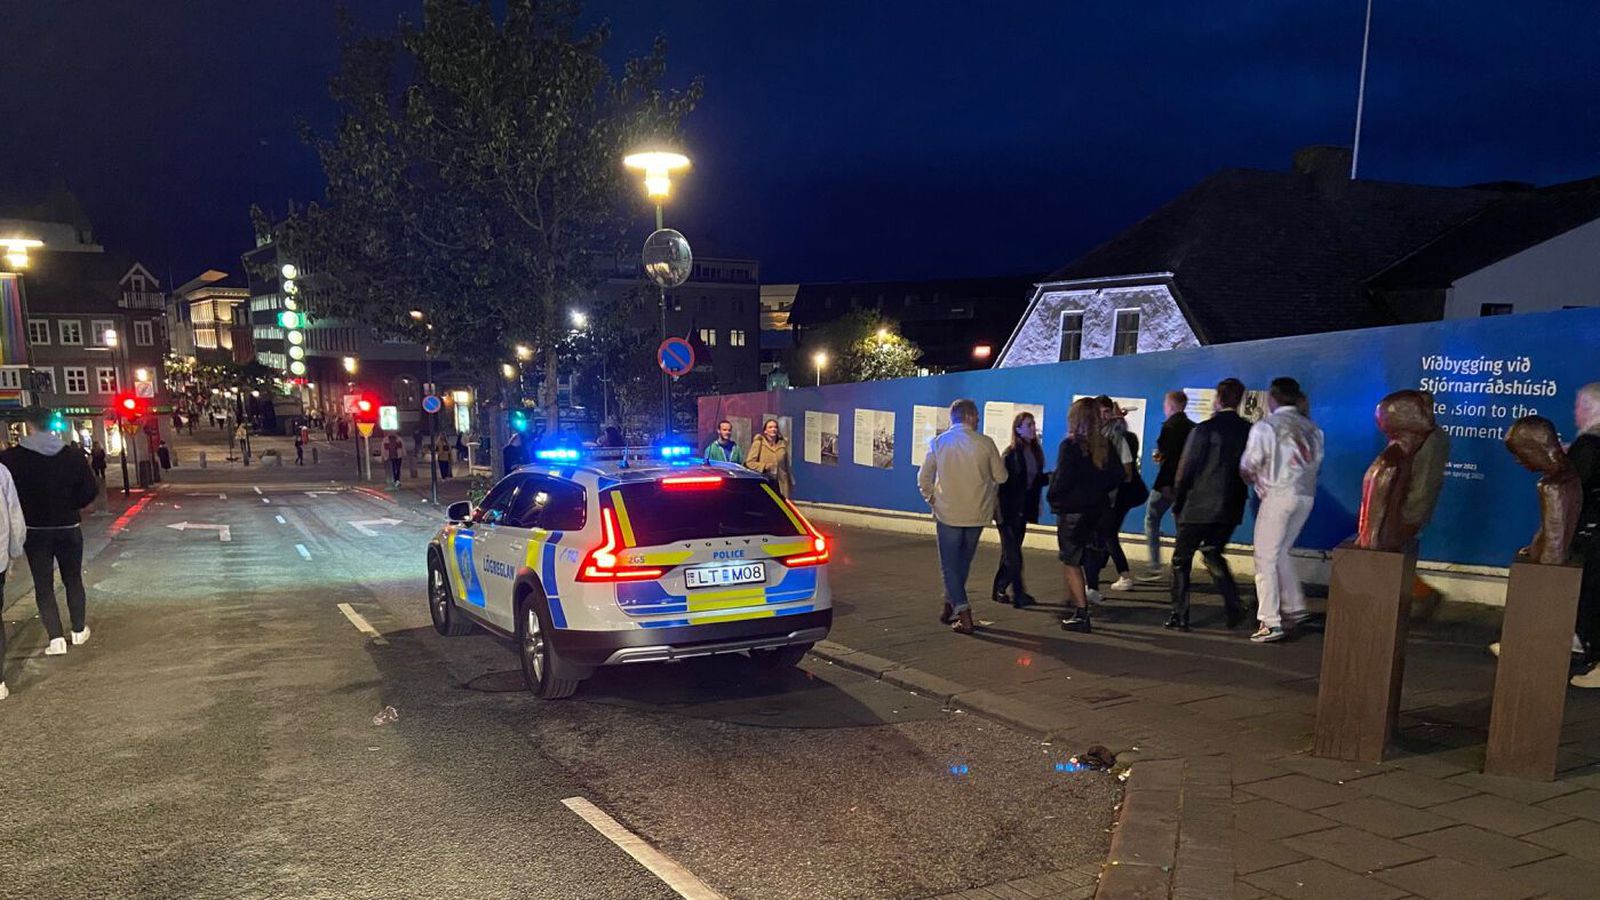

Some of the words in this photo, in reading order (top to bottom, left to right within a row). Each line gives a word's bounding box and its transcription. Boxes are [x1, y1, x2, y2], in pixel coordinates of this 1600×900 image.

[1422, 355, 1503, 375] Viðbygging
[1507, 356, 1531, 373] við
[1420, 376, 1557, 397] Stjórnarráðshúsið
[1491, 404, 1507, 418] to
[1511, 403, 1538, 419] the
[1441, 424, 1503, 440] ernment
[684, 537, 768, 549] VOLVO
[713, 549, 745, 560] POLICE
[698, 570, 719, 584] LT
[731, 565, 762, 581] M08
